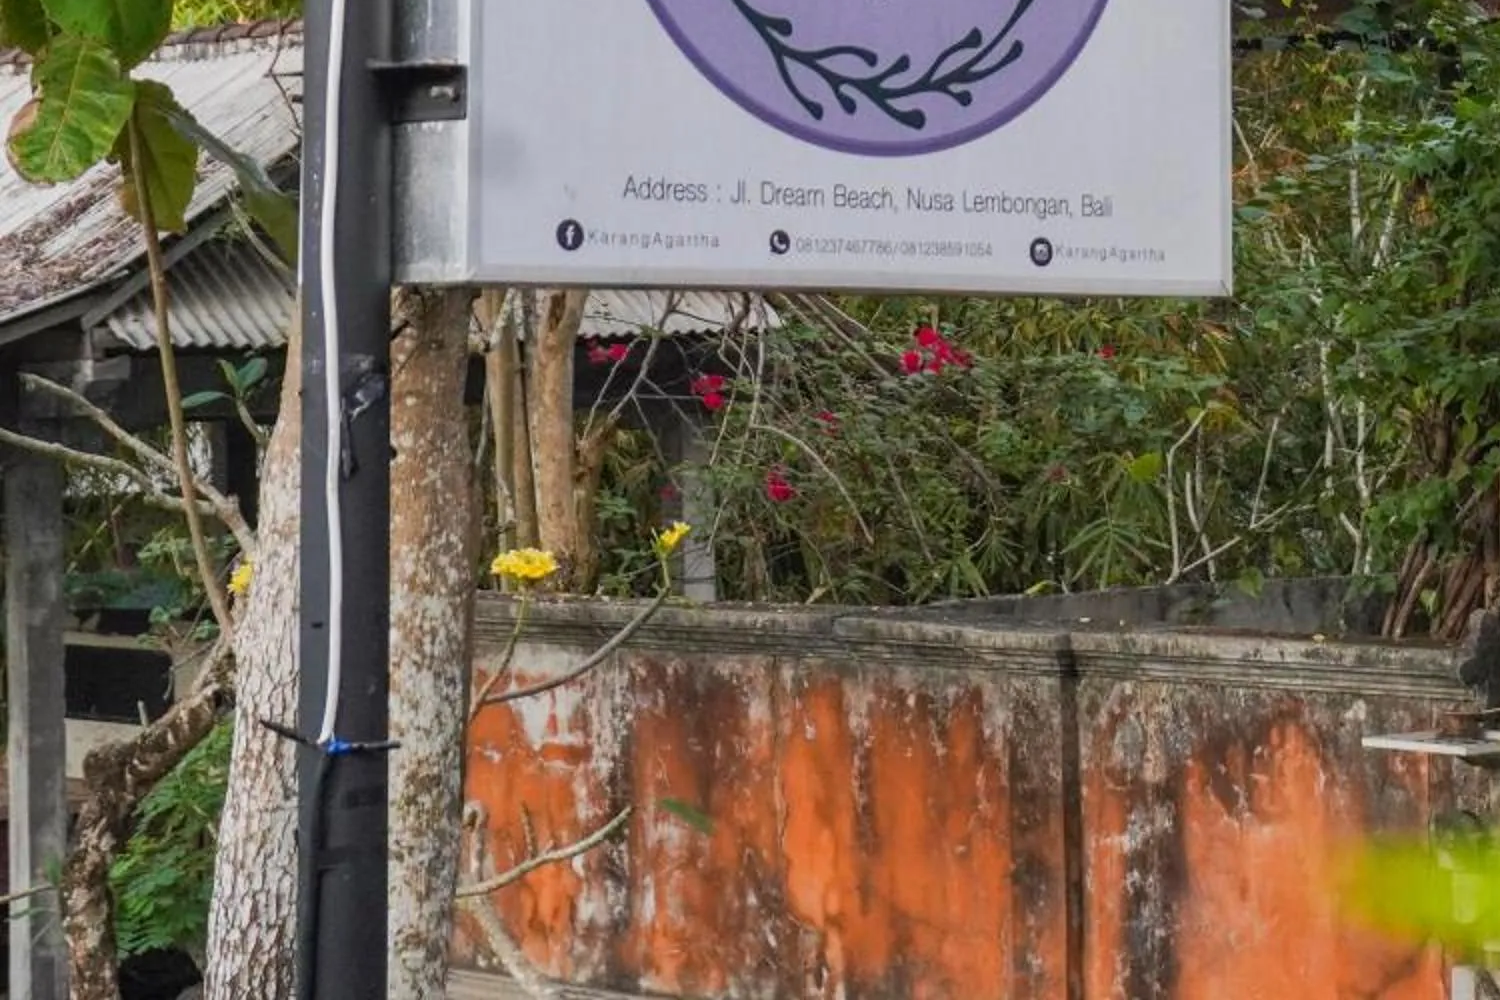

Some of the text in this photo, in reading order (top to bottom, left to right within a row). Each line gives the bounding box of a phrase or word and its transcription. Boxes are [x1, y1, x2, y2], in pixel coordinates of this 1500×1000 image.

[622, 175, 708, 202] Address
[760, 181, 825, 207] Dream
[833, 184, 899, 213] Beach,
[906, 187, 954, 213] Nusa
[962, 190, 1074, 220] Lembongan,
[1080, 193, 1113, 218] Bali
[587, 230, 720, 250] KarangAgartha
[1055, 244, 1166, 263] KarangAgartha
